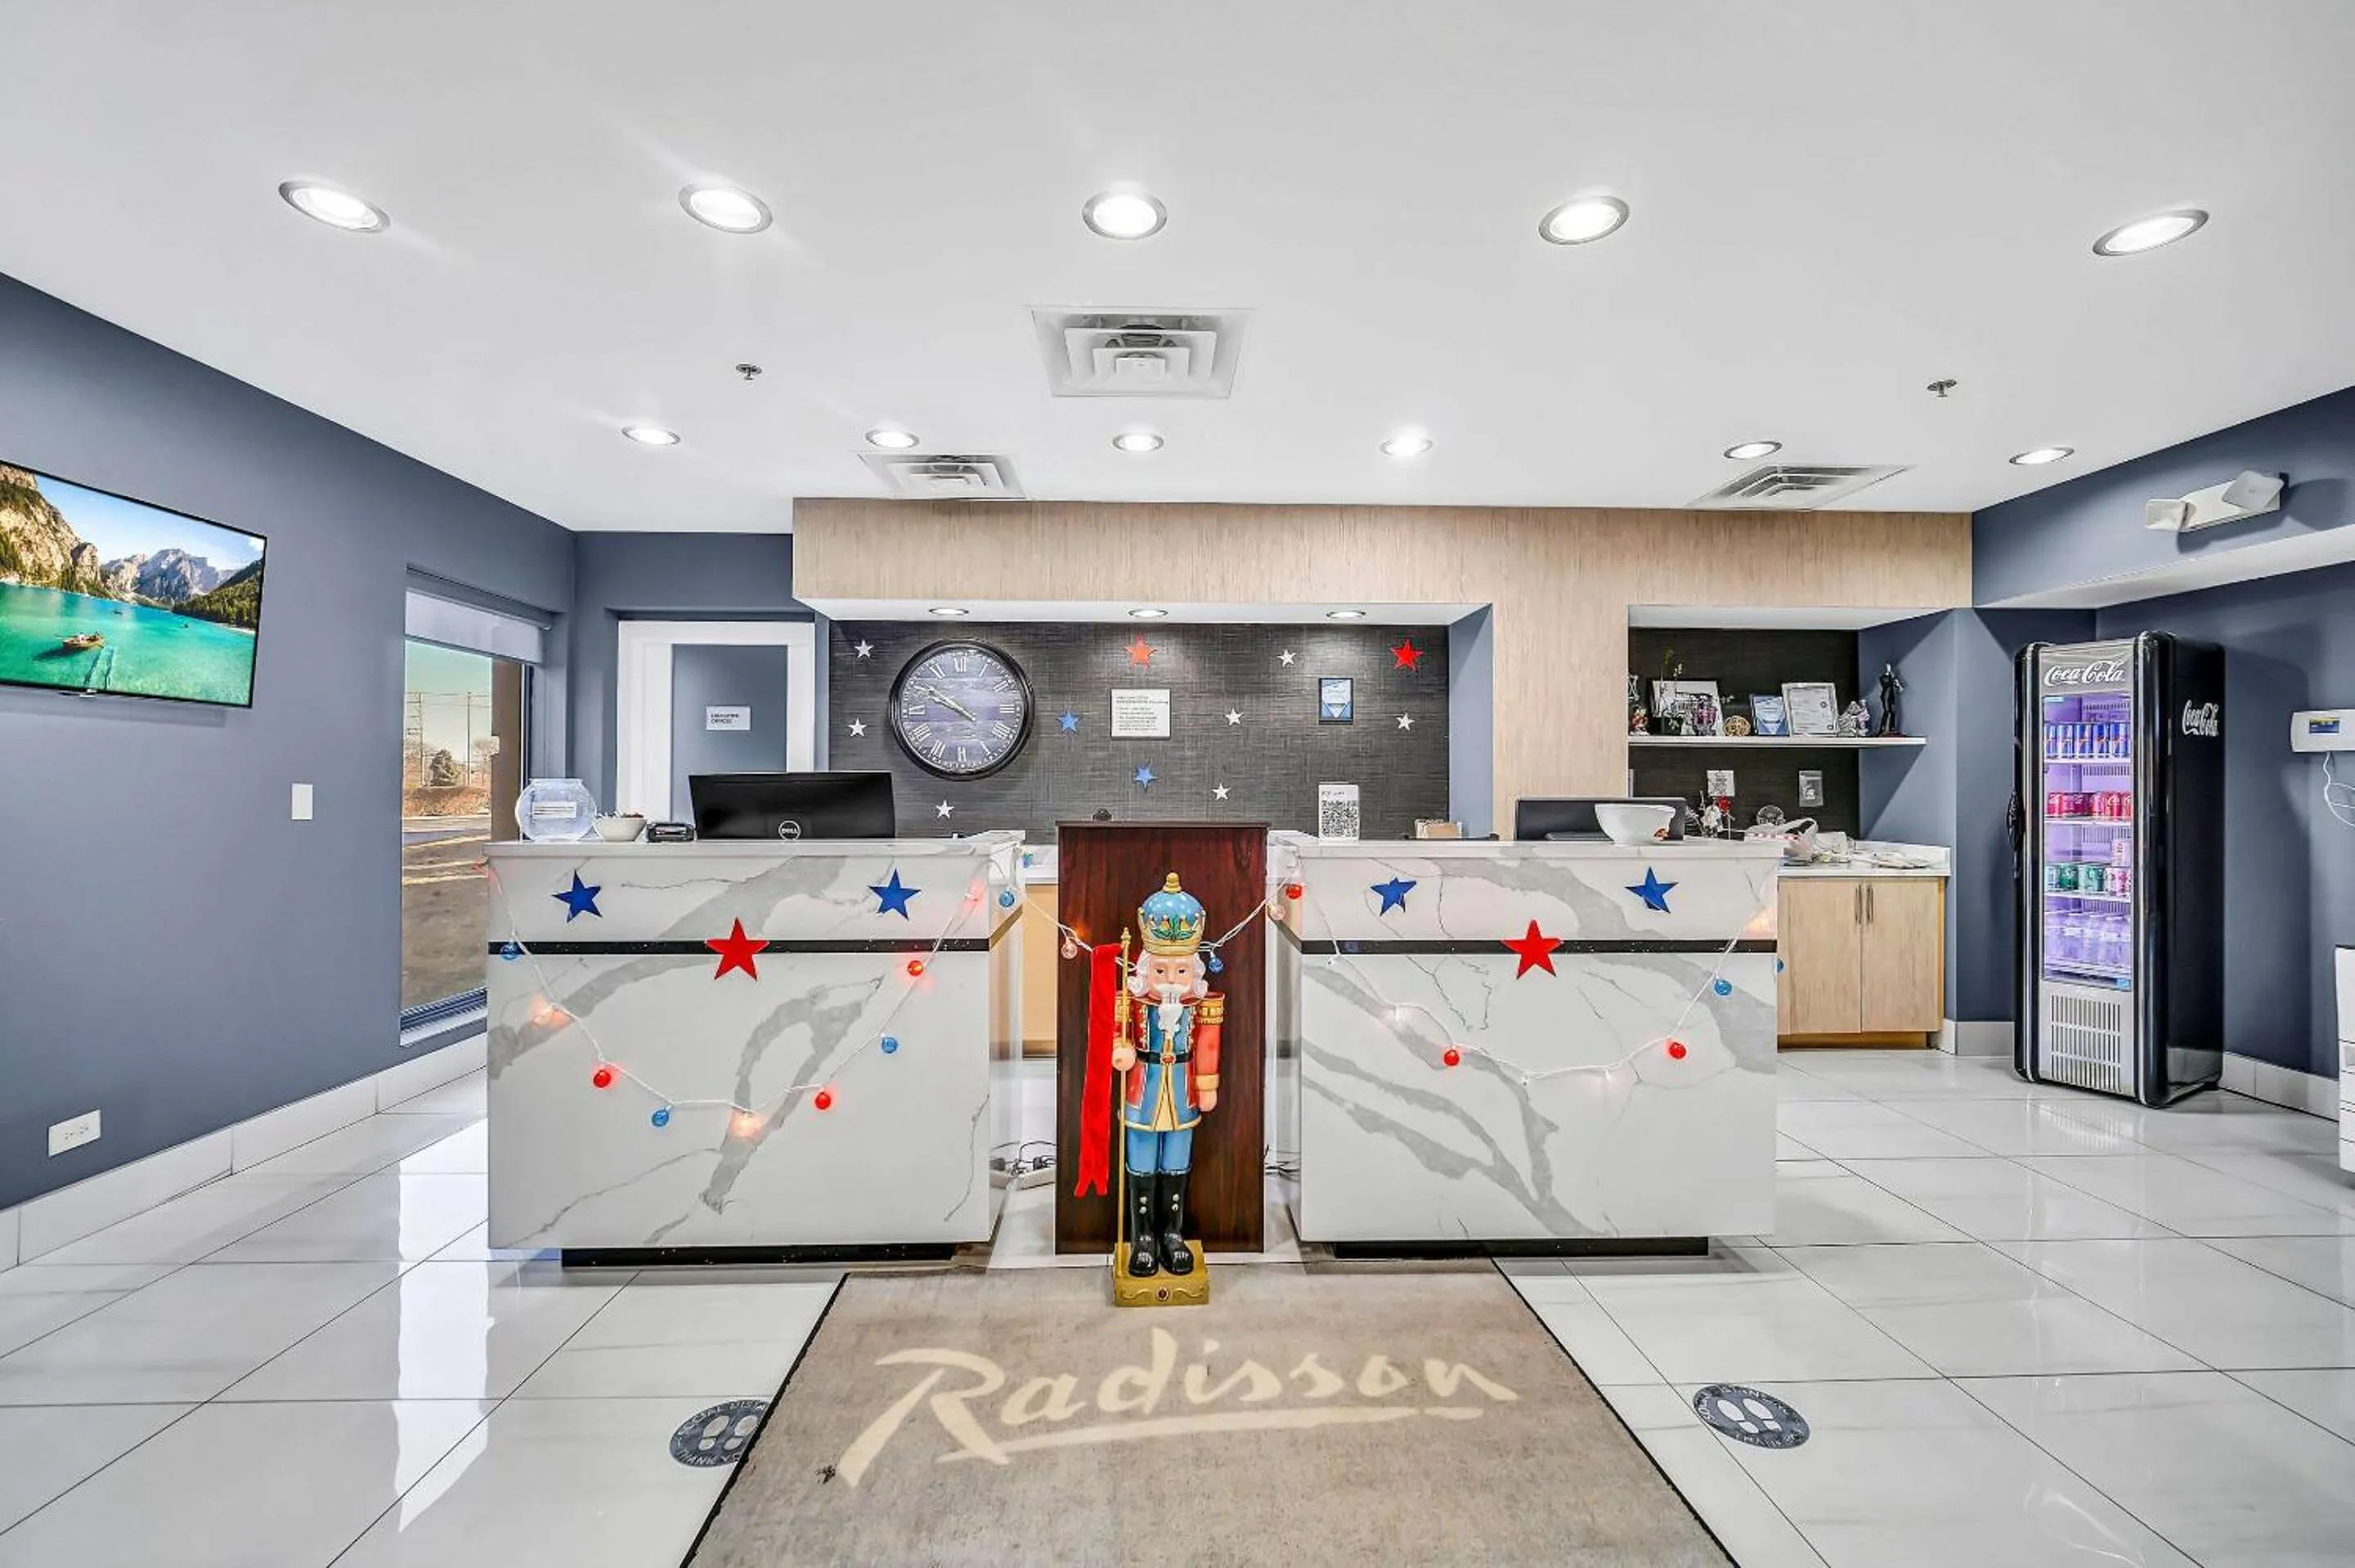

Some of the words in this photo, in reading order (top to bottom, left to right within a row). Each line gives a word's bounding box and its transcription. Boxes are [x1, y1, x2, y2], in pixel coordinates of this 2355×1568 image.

[2045, 661, 2126, 686] Coca-Cola
[998, 703, 1015, 714] III
[839, 1328, 1519, 1488] Radisson
